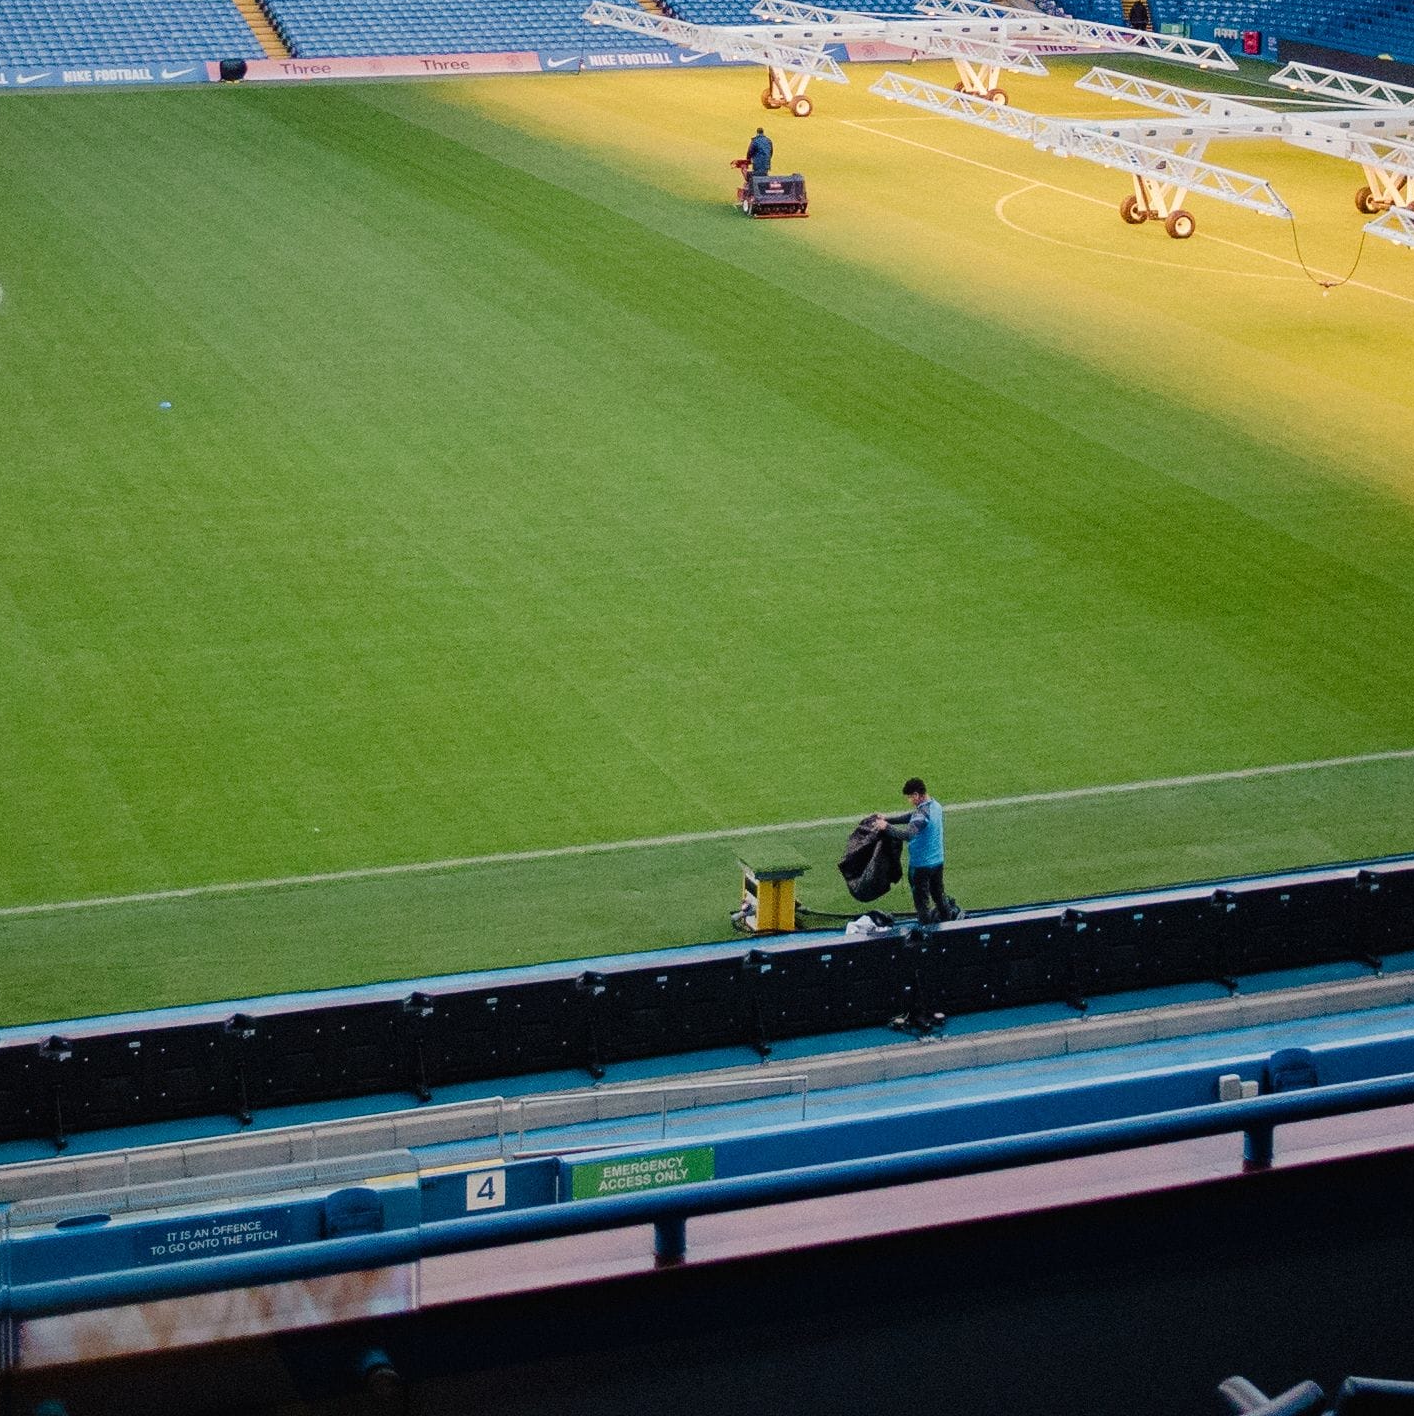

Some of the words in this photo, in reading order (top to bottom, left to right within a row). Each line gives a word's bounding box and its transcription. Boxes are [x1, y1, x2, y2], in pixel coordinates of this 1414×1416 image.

[280, 63, 331, 75] Three
[420, 59, 470, 71] Three
[588, 54, 617, 66] NIKE
[618, 52, 673, 65] FOOTBALL
[63, 70, 92, 83] NIKE
[94, 68, 154, 82] FOOTBALL
[603, 1156, 685, 1179] EMERGENCY
[477, 1176, 496, 1200] 4
[598, 1174, 652, 1192] ACCESS
[654, 1167, 689, 1184] ONLY
[150, 1245, 166, 1256] TO
[168, 1242, 186, 1254] GO
[188, 1238, 220, 1251] ONTO
[222, 1235, 243, 1246] THE
[245, 1229, 278, 1243] PITCH
[167, 1232, 177, 1243] IT
[180, 1230, 191, 1241] IS
[194, 1228, 209, 1239] AN
[212, 1220, 262, 1236] OFFENCE
